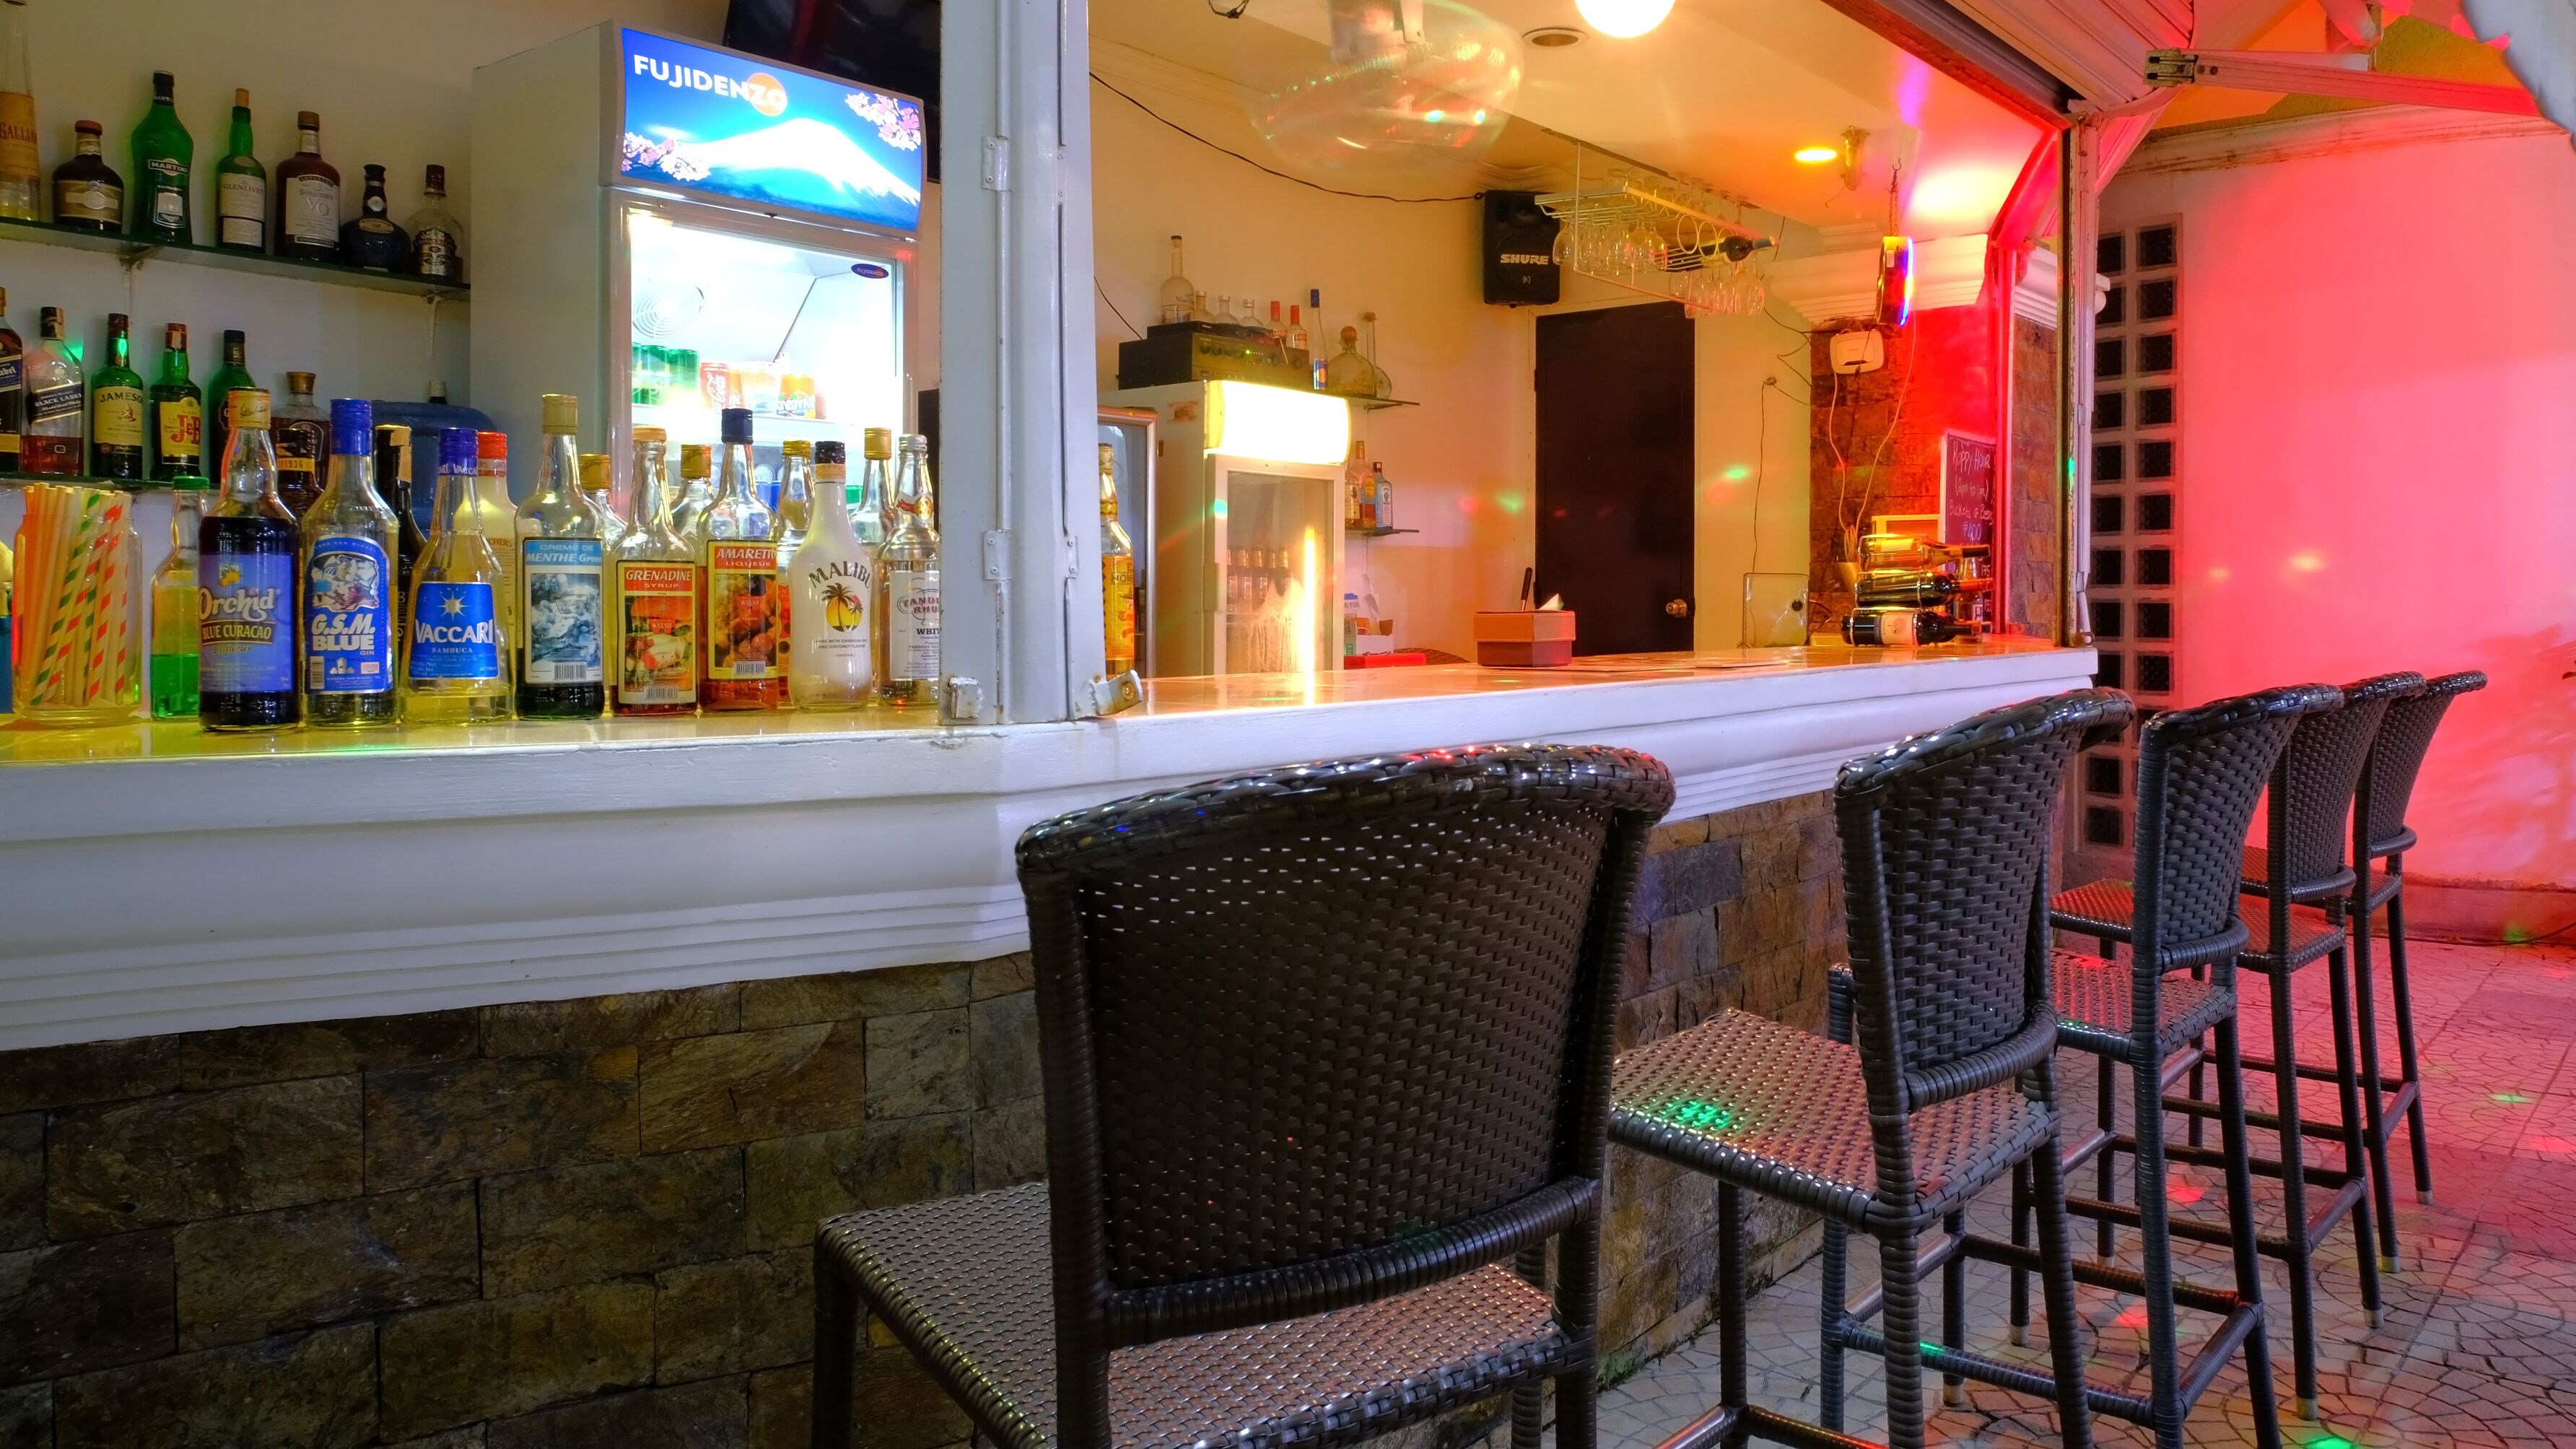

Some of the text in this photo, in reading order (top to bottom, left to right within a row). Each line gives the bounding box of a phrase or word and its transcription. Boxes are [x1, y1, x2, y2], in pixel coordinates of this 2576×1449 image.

[634, 54, 787, 107] FUJIDENZO
[152, 162, 188, 174] MARTINI
[307, 196, 330, 216] VO
[1500, 253, 1549, 265] SHURE
[857, 267, 884, 277] FUJIDENZO
[0, 366, 17, 375] abel
[35, 398, 58, 406] BLACK
[100, 392, 143, 404] JAMESO
[284, 460, 303, 469] 1936
[453, 463, 477, 475] VACCA
[489, 537, 512, 547] CHERS
[525, 553, 577, 562] MENTHE
[717, 549, 776, 560] AMARETTO
[626, 570, 691, 581] GRENADINE
[808, 561, 871, 589] MALIBU
[199, 588, 275, 622] Orchid
[311, 614, 376, 635] G.S.M.
[202, 625, 272, 640] BLUE CURACAO
[415, 619, 494, 644] VACCARI
[313, 635, 375, 651] BLUE
